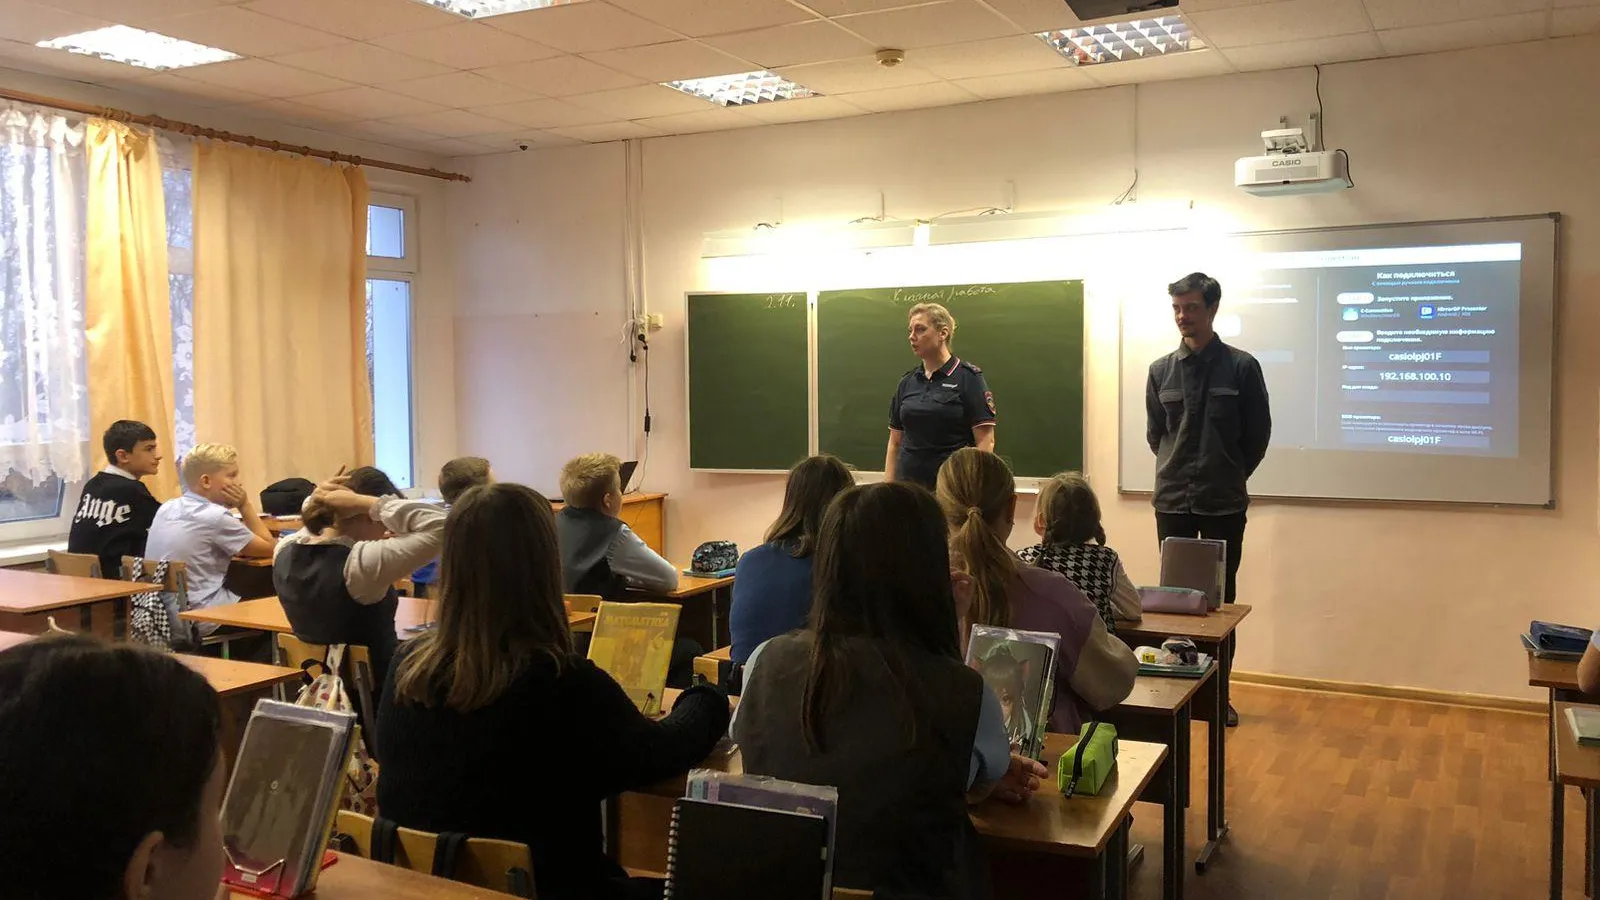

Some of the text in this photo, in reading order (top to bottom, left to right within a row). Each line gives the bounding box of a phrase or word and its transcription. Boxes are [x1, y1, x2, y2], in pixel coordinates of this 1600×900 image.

[1271, 159, 1302, 167] CASIO
[1376, 270, 1456, 281] Как подключиться
[1379, 372, 1452, 381] 192.168.100.10
